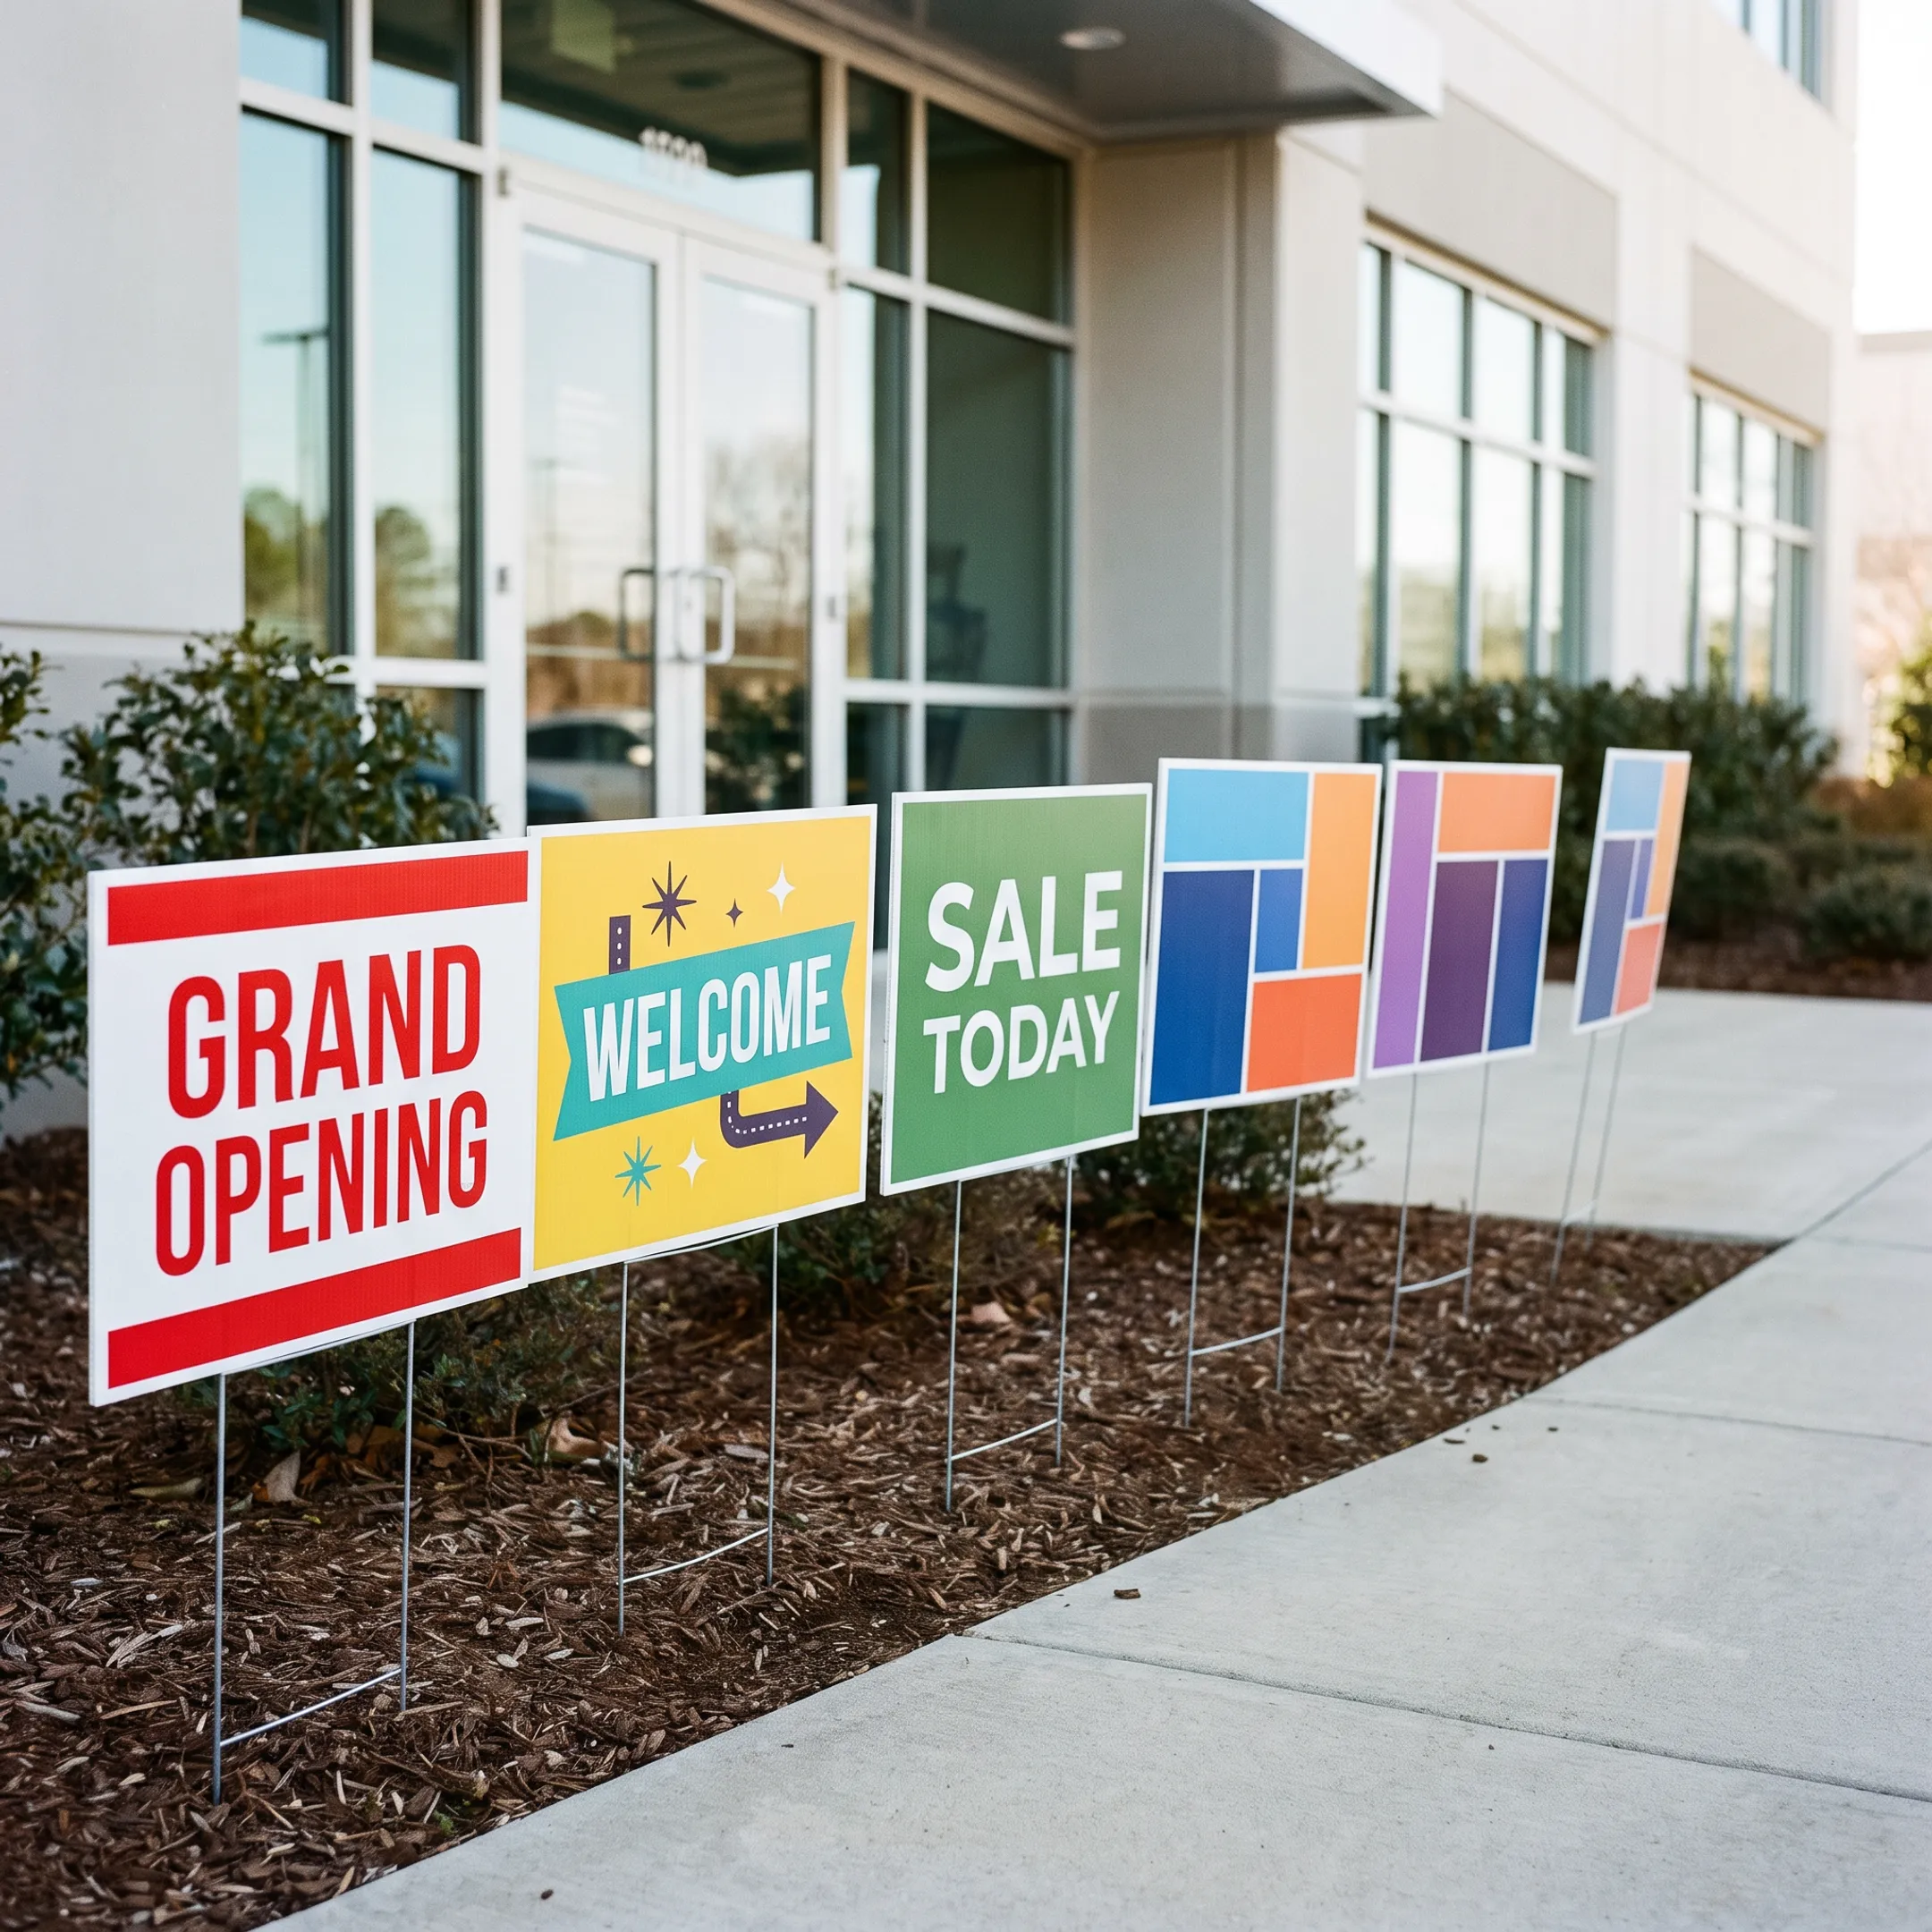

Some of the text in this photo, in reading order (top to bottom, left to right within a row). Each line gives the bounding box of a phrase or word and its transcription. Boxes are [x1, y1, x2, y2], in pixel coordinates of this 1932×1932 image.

[925, 869, 1123, 992] SALE
[168, 945, 480, 1118] GRAND
[583, 953, 832, 1102] WELCOME
[922, 990, 1120, 1095] TODAY
[156, 1090, 487, 1276] OPENING
